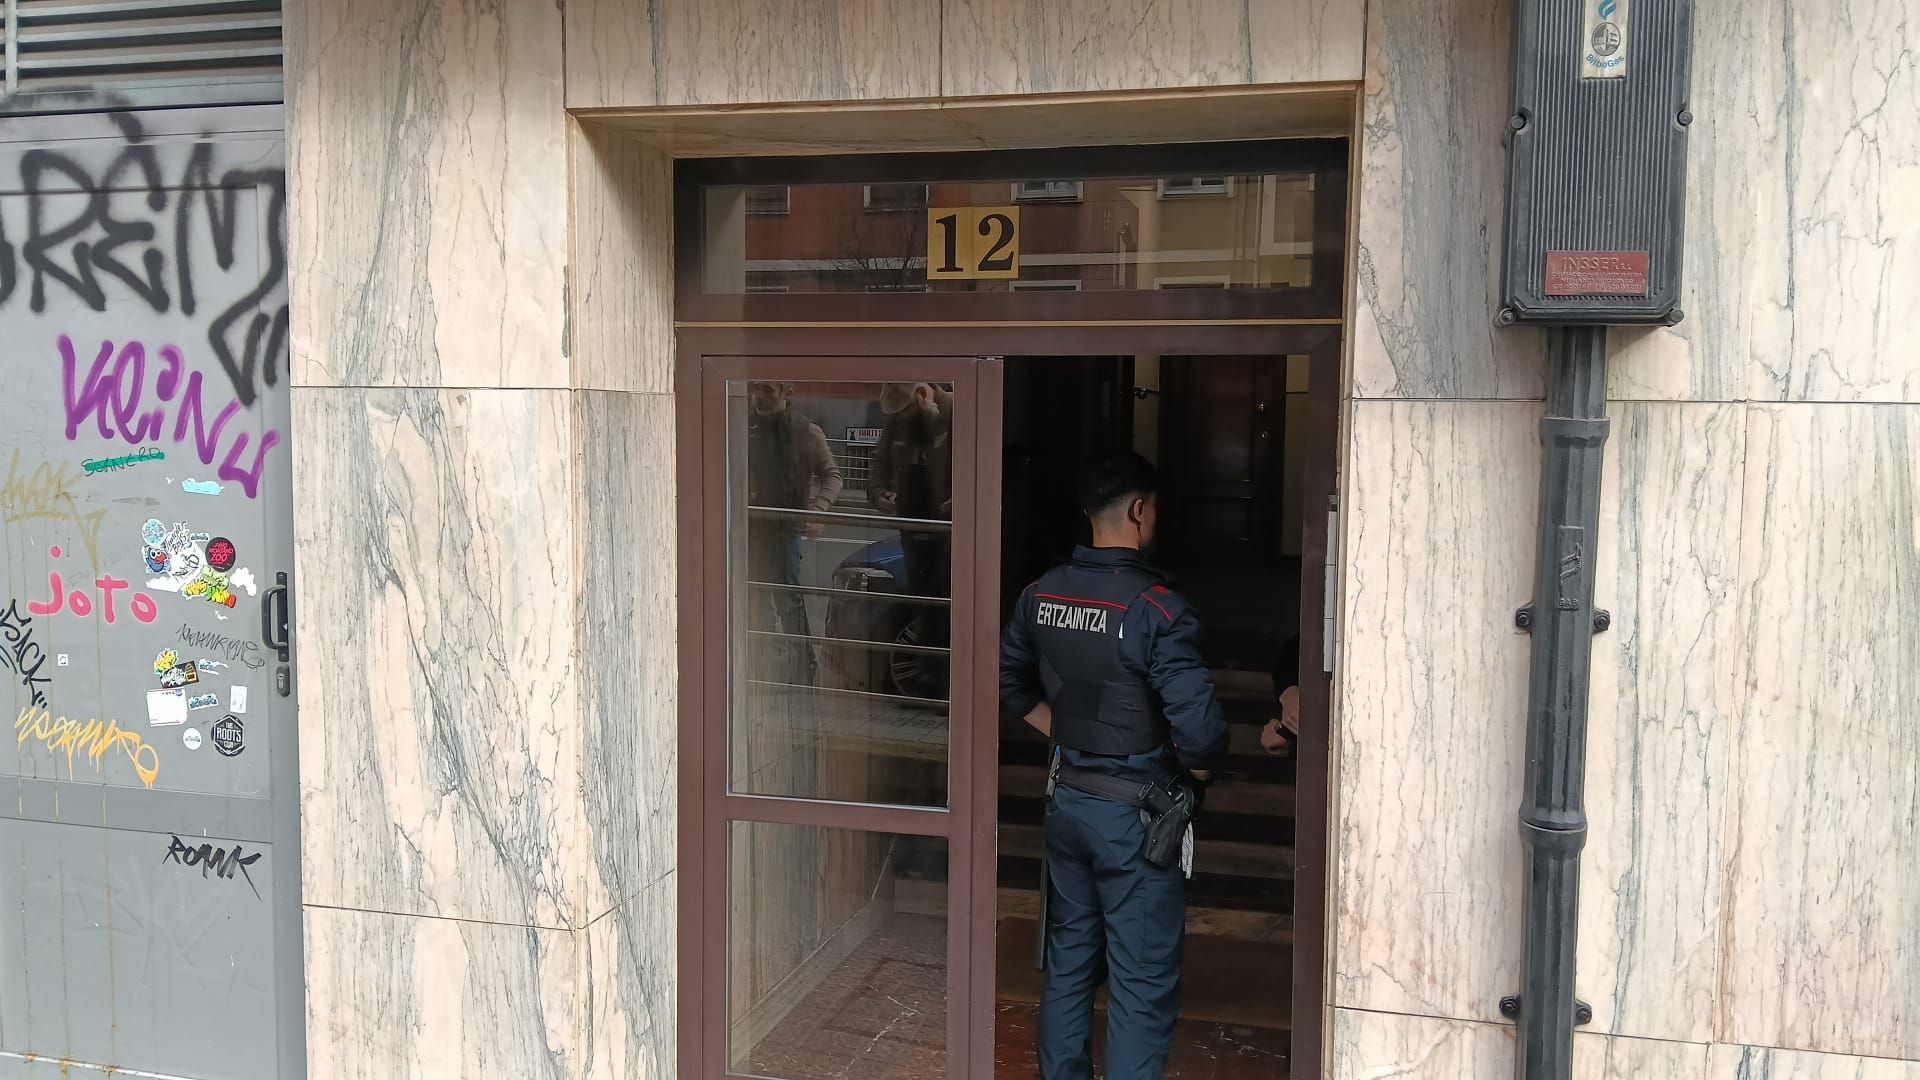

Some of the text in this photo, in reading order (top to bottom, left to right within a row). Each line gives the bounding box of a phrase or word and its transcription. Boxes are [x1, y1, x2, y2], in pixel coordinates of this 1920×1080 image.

[1586, 53, 1625, 68] BilboGas
[935, 213, 1015, 273] 12
[1036, 602, 1107, 634] ERTZAINTZA
[216, 727, 241, 743] ROOTS
